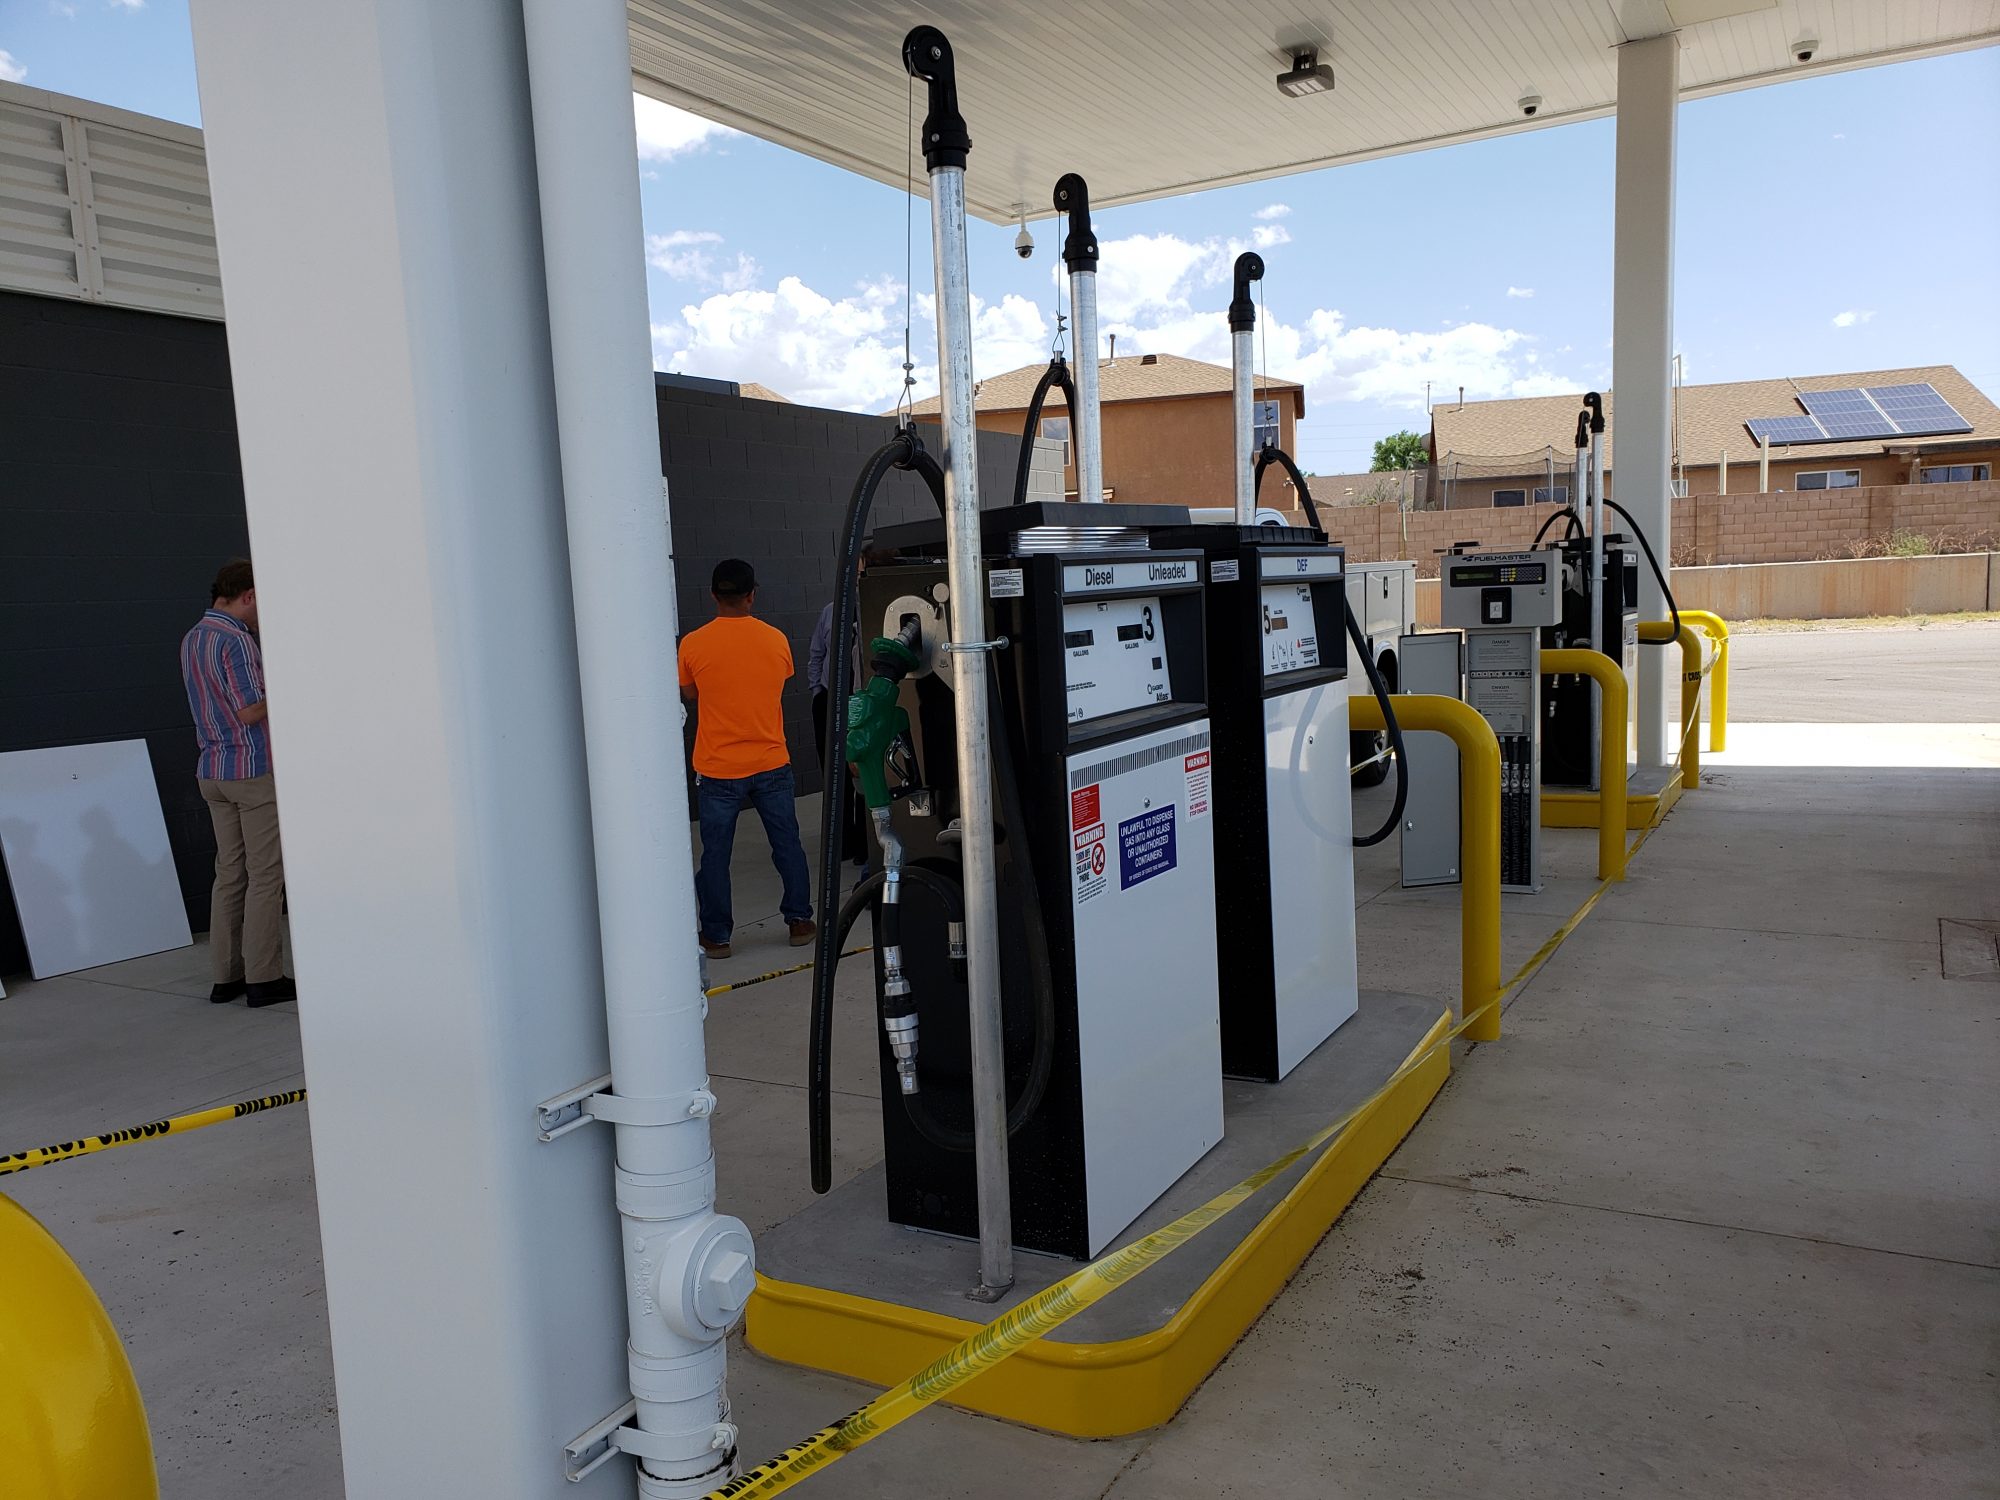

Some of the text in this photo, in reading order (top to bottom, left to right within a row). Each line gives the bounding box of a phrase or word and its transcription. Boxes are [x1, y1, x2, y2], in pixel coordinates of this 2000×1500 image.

[1297, 559, 1308, 572] DEF
[1474, 554, 1531, 562] FUELMASTER
[1085, 563, 1186, 586] Diesel Unleaded
[1143, 606, 1155, 642] 3
[1263, 605, 1271, 635] 5
[1073, 650, 1089, 658] GALLONS
[1125, 642, 1139, 650] GALLONS
[1187, 755, 1207, 769] WARNING
[1120, 810, 1173, 837] UNLAWFUL TO DISPENSE
[1125, 822, 1170, 847] GAS INTO ANY GLASS
[1076, 826, 1104, 848] WARNING
[1127, 835, 1169, 858] OR UNAUTHORIZED
[1135, 848, 1163, 868] CONTAINERS
